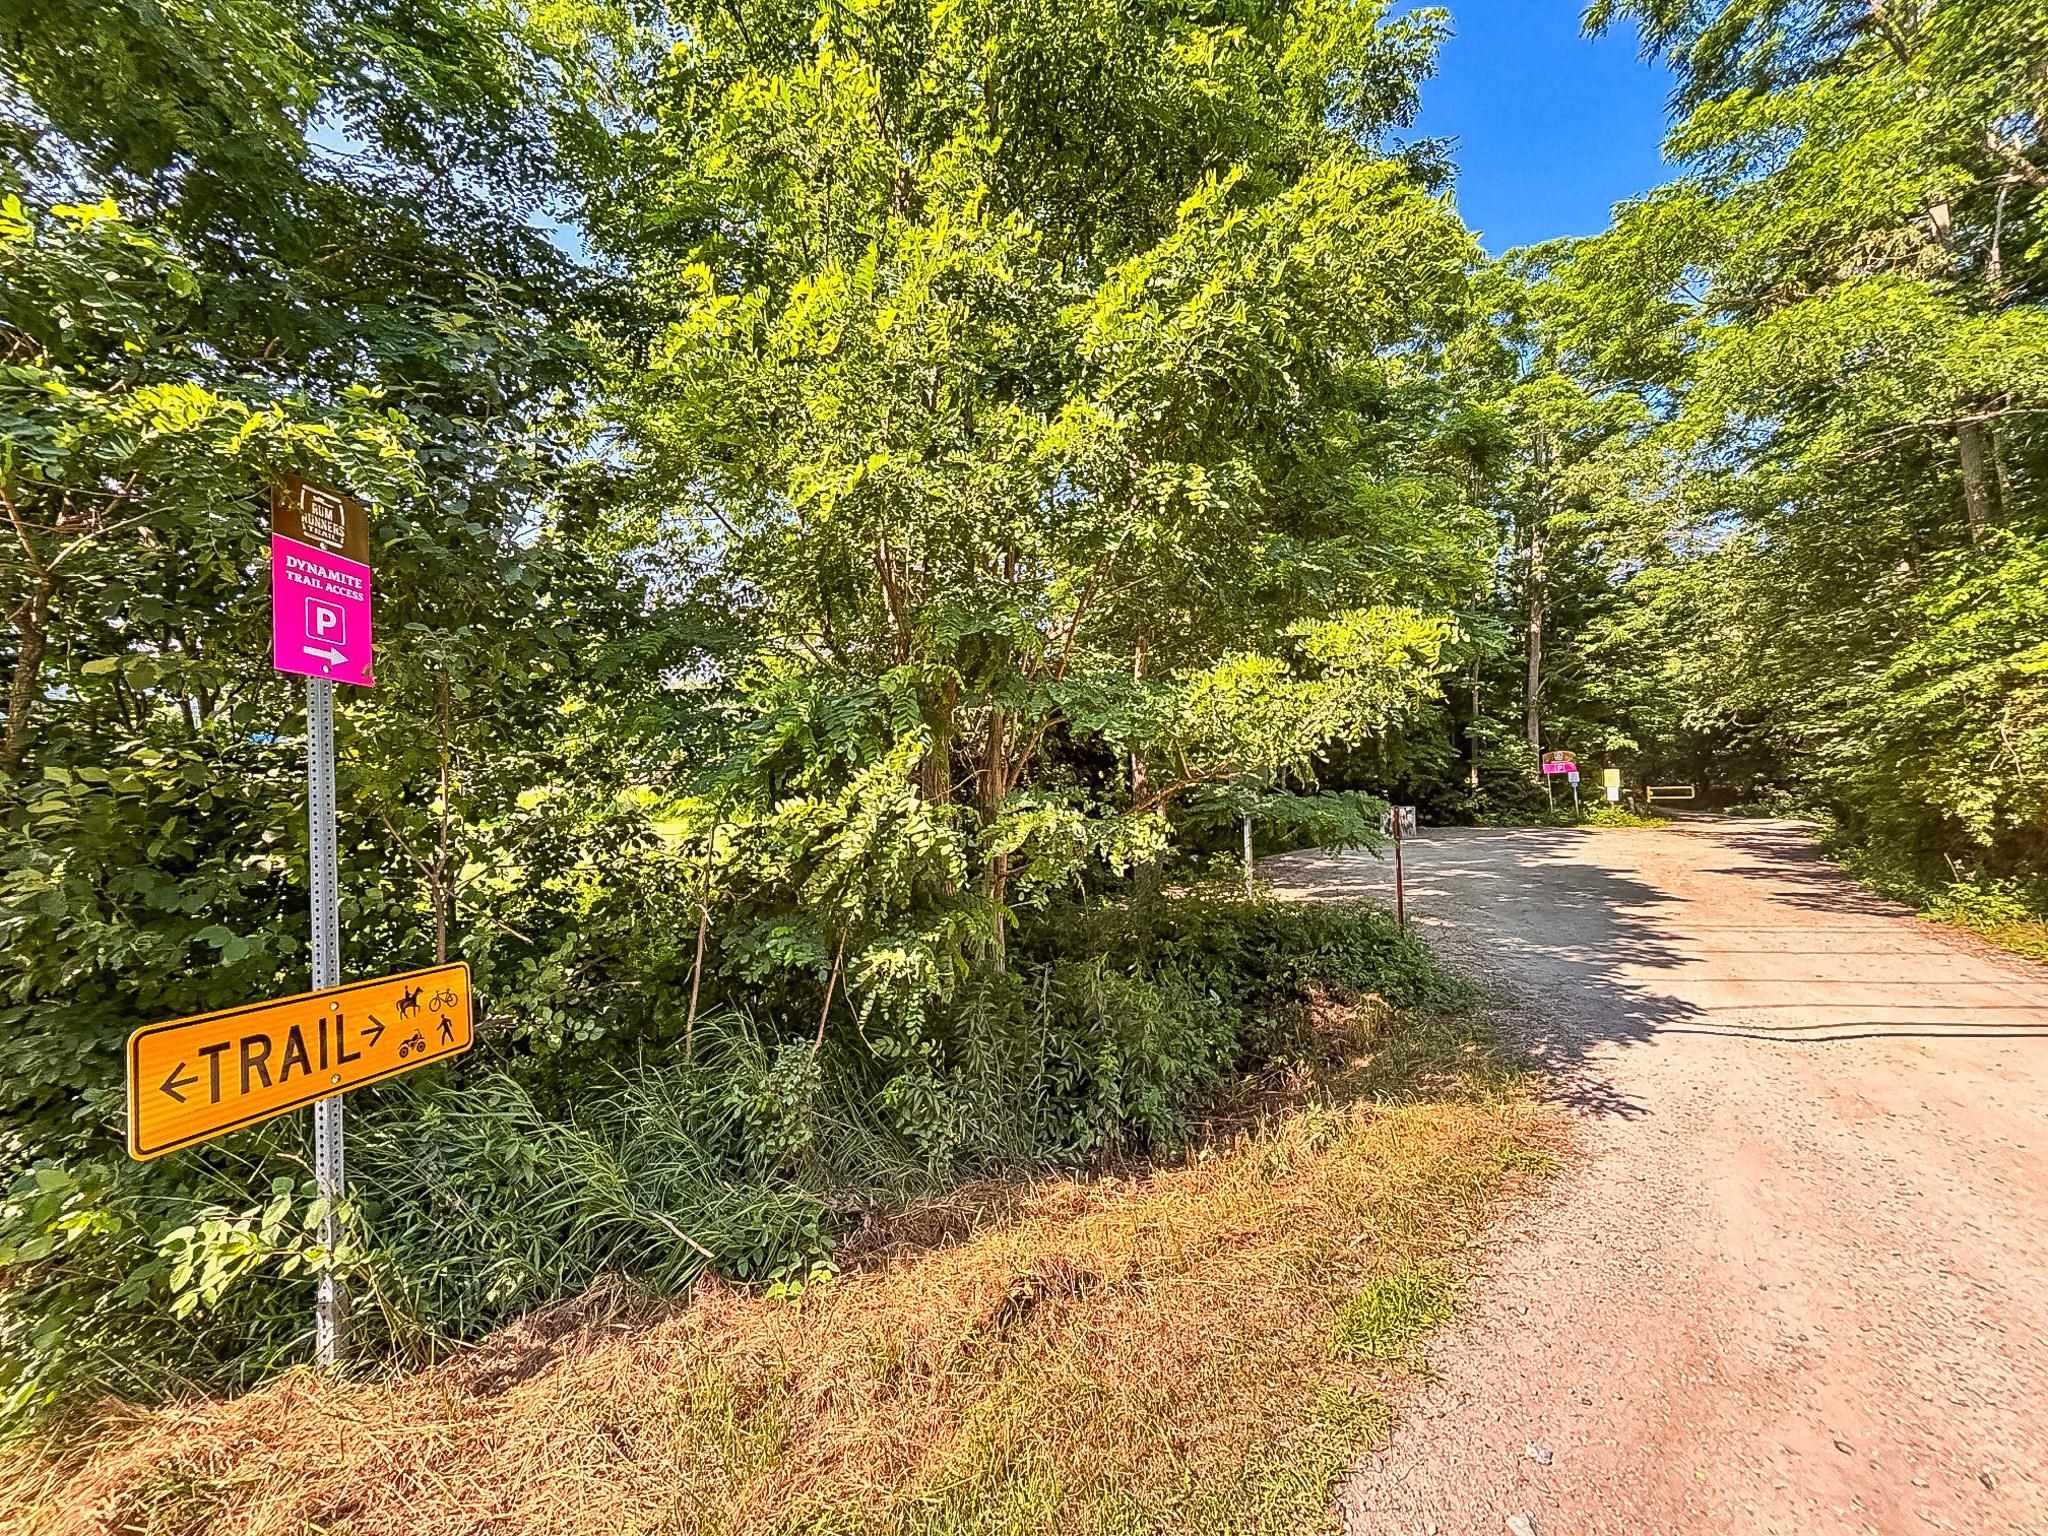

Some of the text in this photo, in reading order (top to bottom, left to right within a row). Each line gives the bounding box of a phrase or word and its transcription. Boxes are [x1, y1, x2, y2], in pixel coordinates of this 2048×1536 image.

[302, 512, 345, 537] RUNNERS
[311, 502, 333, 521] RUM
[307, 525, 338, 541] TRAIL
[286, 555, 363, 589] DYNAMITE
[286, 570, 364, 602] TRAIL ACCESS
[316, 607, 337, 636] P
[198, 1013, 361, 1104] TRAIL
